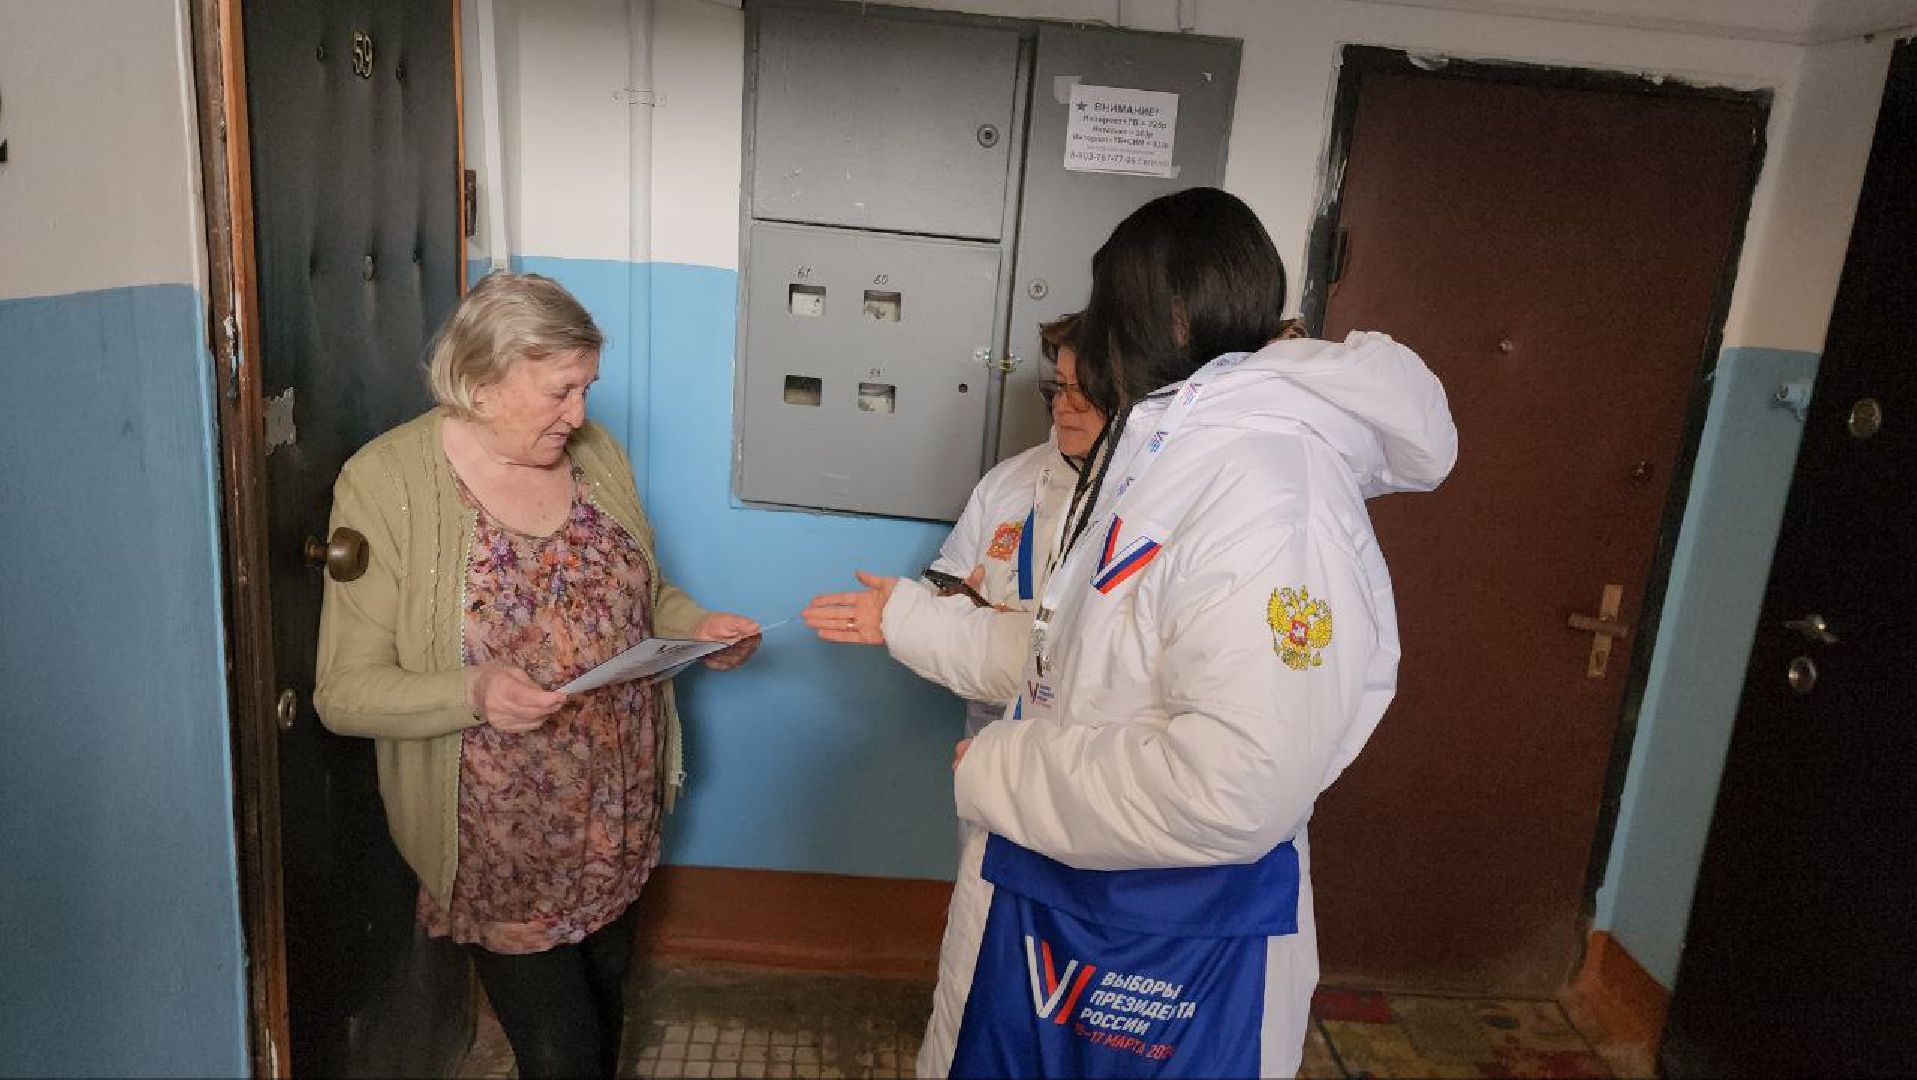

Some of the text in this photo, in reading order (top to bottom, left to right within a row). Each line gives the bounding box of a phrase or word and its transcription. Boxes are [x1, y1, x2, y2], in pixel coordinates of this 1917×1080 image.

[353, 31, 373, 77] 59
[1094, 102, 1160, 117] ВНИМАНИЕ!
[1101, 971, 1183, 1000] ВЫБОРЫ
[1080, 1007, 1151, 1036] РОССИИ
[1103, 1033, 1146, 1055] МАРТА
